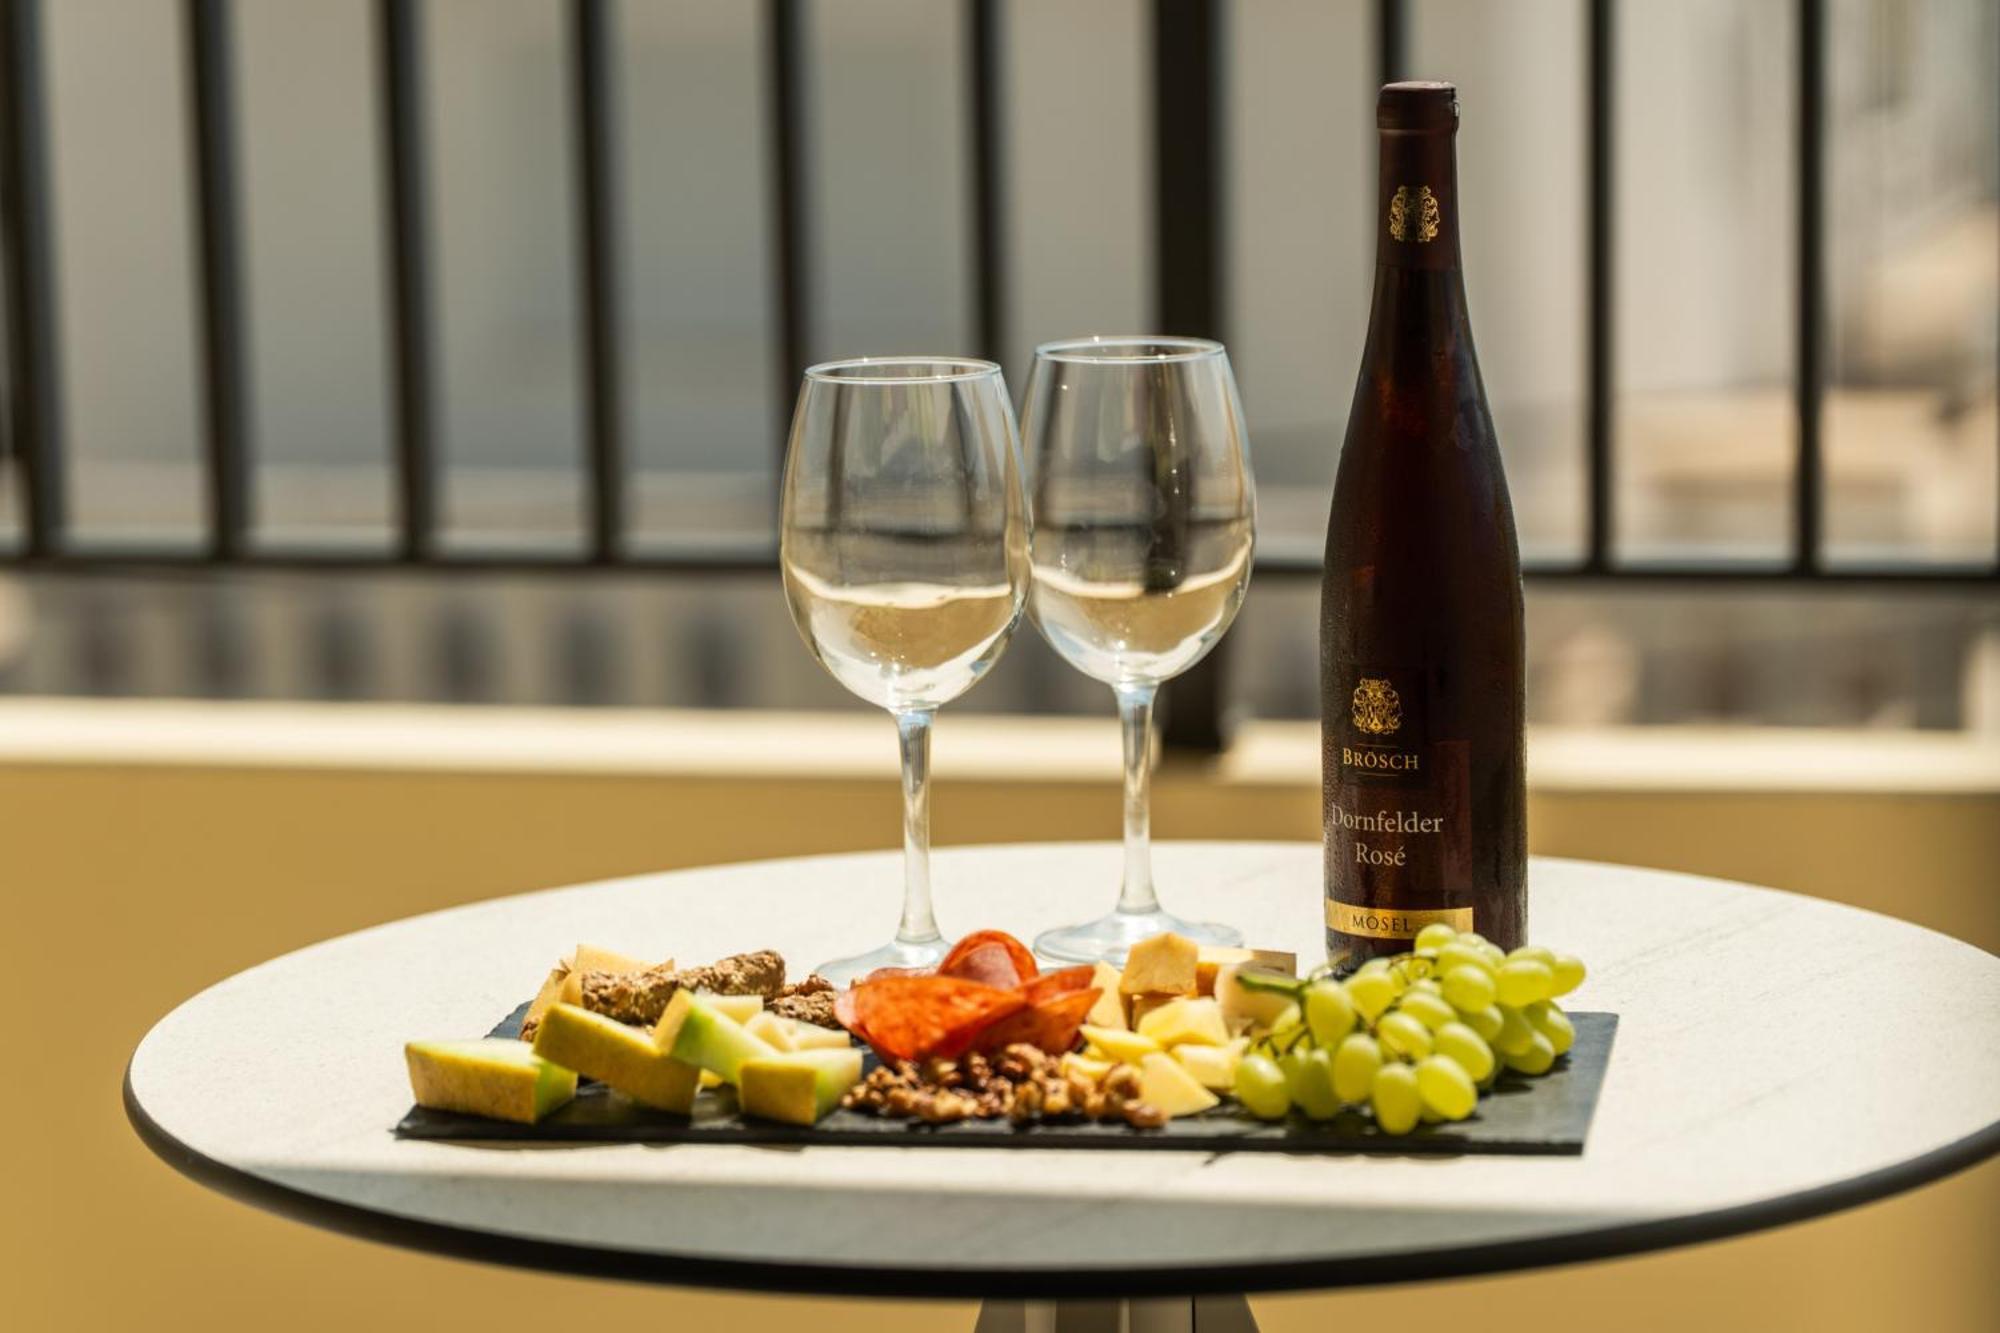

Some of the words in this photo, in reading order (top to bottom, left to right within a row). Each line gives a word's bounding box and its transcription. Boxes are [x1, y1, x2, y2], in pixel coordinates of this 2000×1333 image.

[1343, 748, 1419, 770] BRÖSCH
[1331, 802, 1444, 833] Dornfelder
[1355, 842, 1407, 867] Rosé
[1352, 914, 1412, 933] MOSEL
